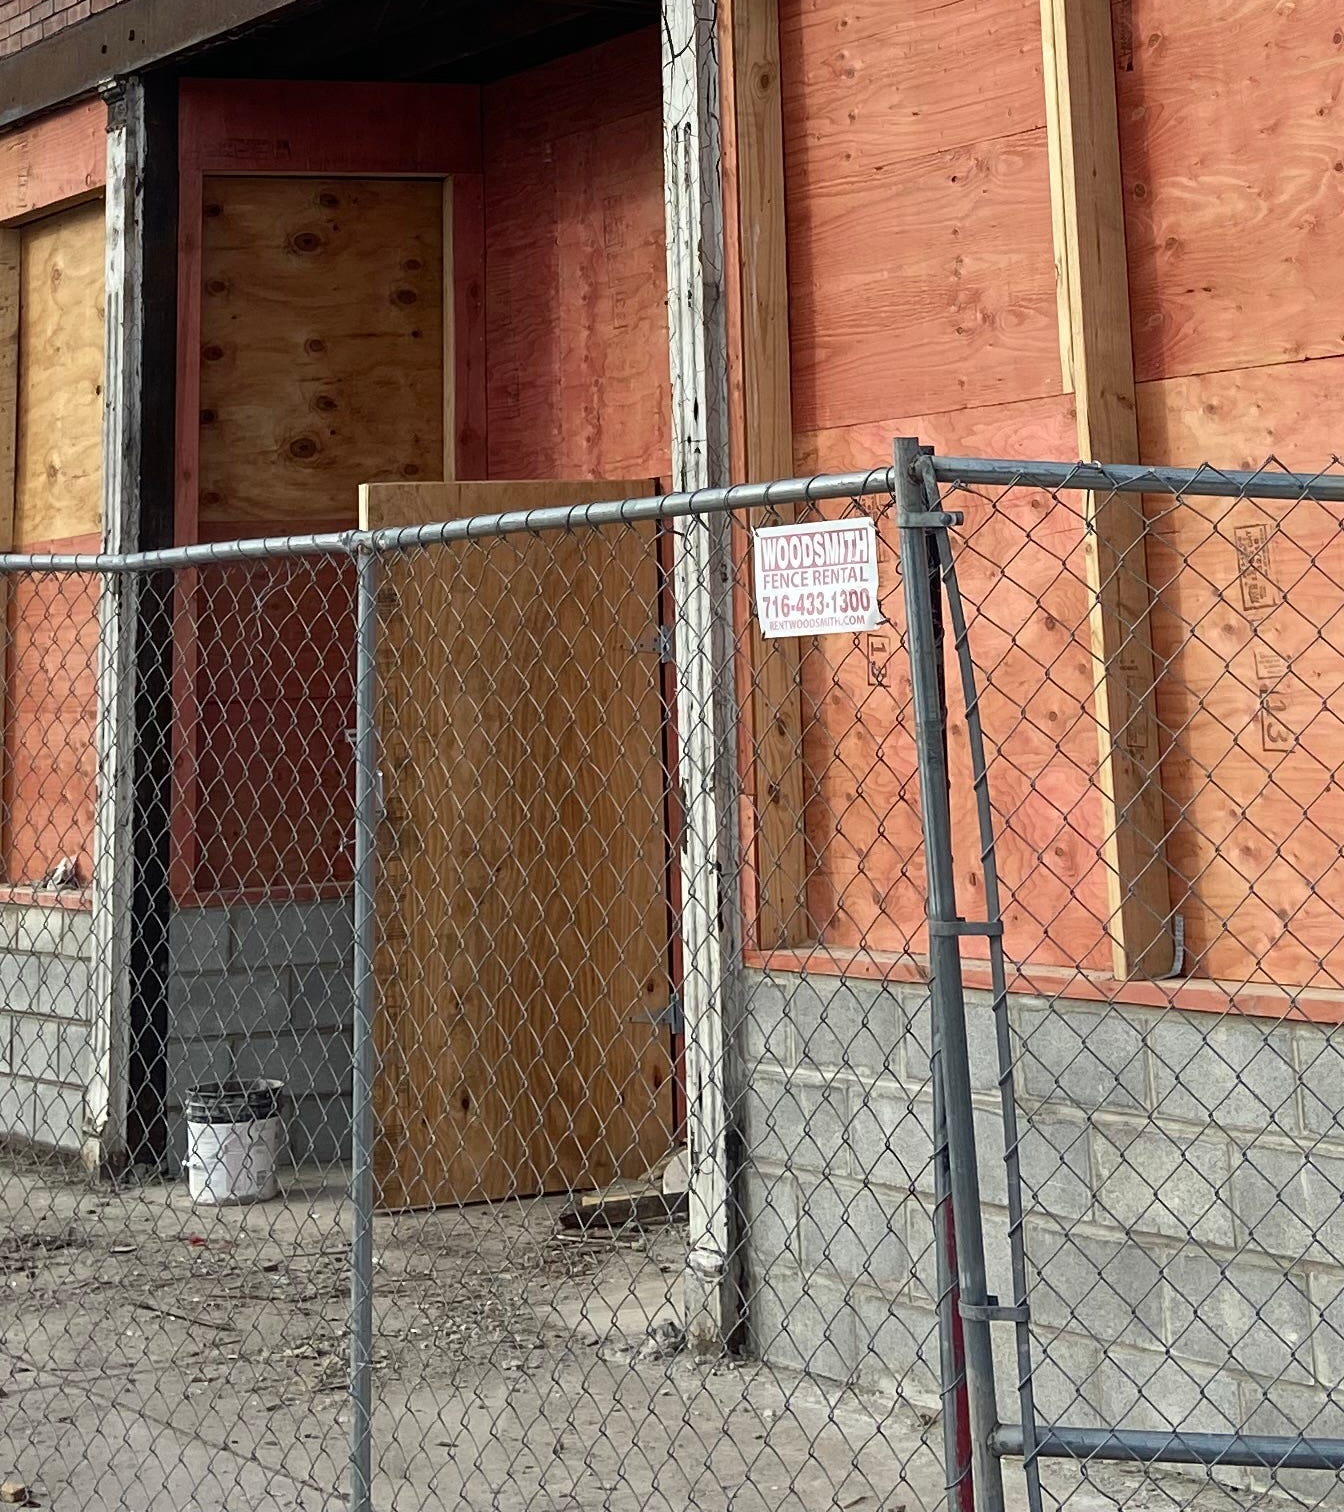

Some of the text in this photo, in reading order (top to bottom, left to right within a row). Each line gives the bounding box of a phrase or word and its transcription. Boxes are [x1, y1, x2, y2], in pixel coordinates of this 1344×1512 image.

[763, 530, 868, 569] WOODSMITH
[763, 566, 868, 590] FENCE RENTAL
[763, 588, 870, 619] 716-433-1300
[769, 615, 865, 631] RENTWOODSMITH.COM
